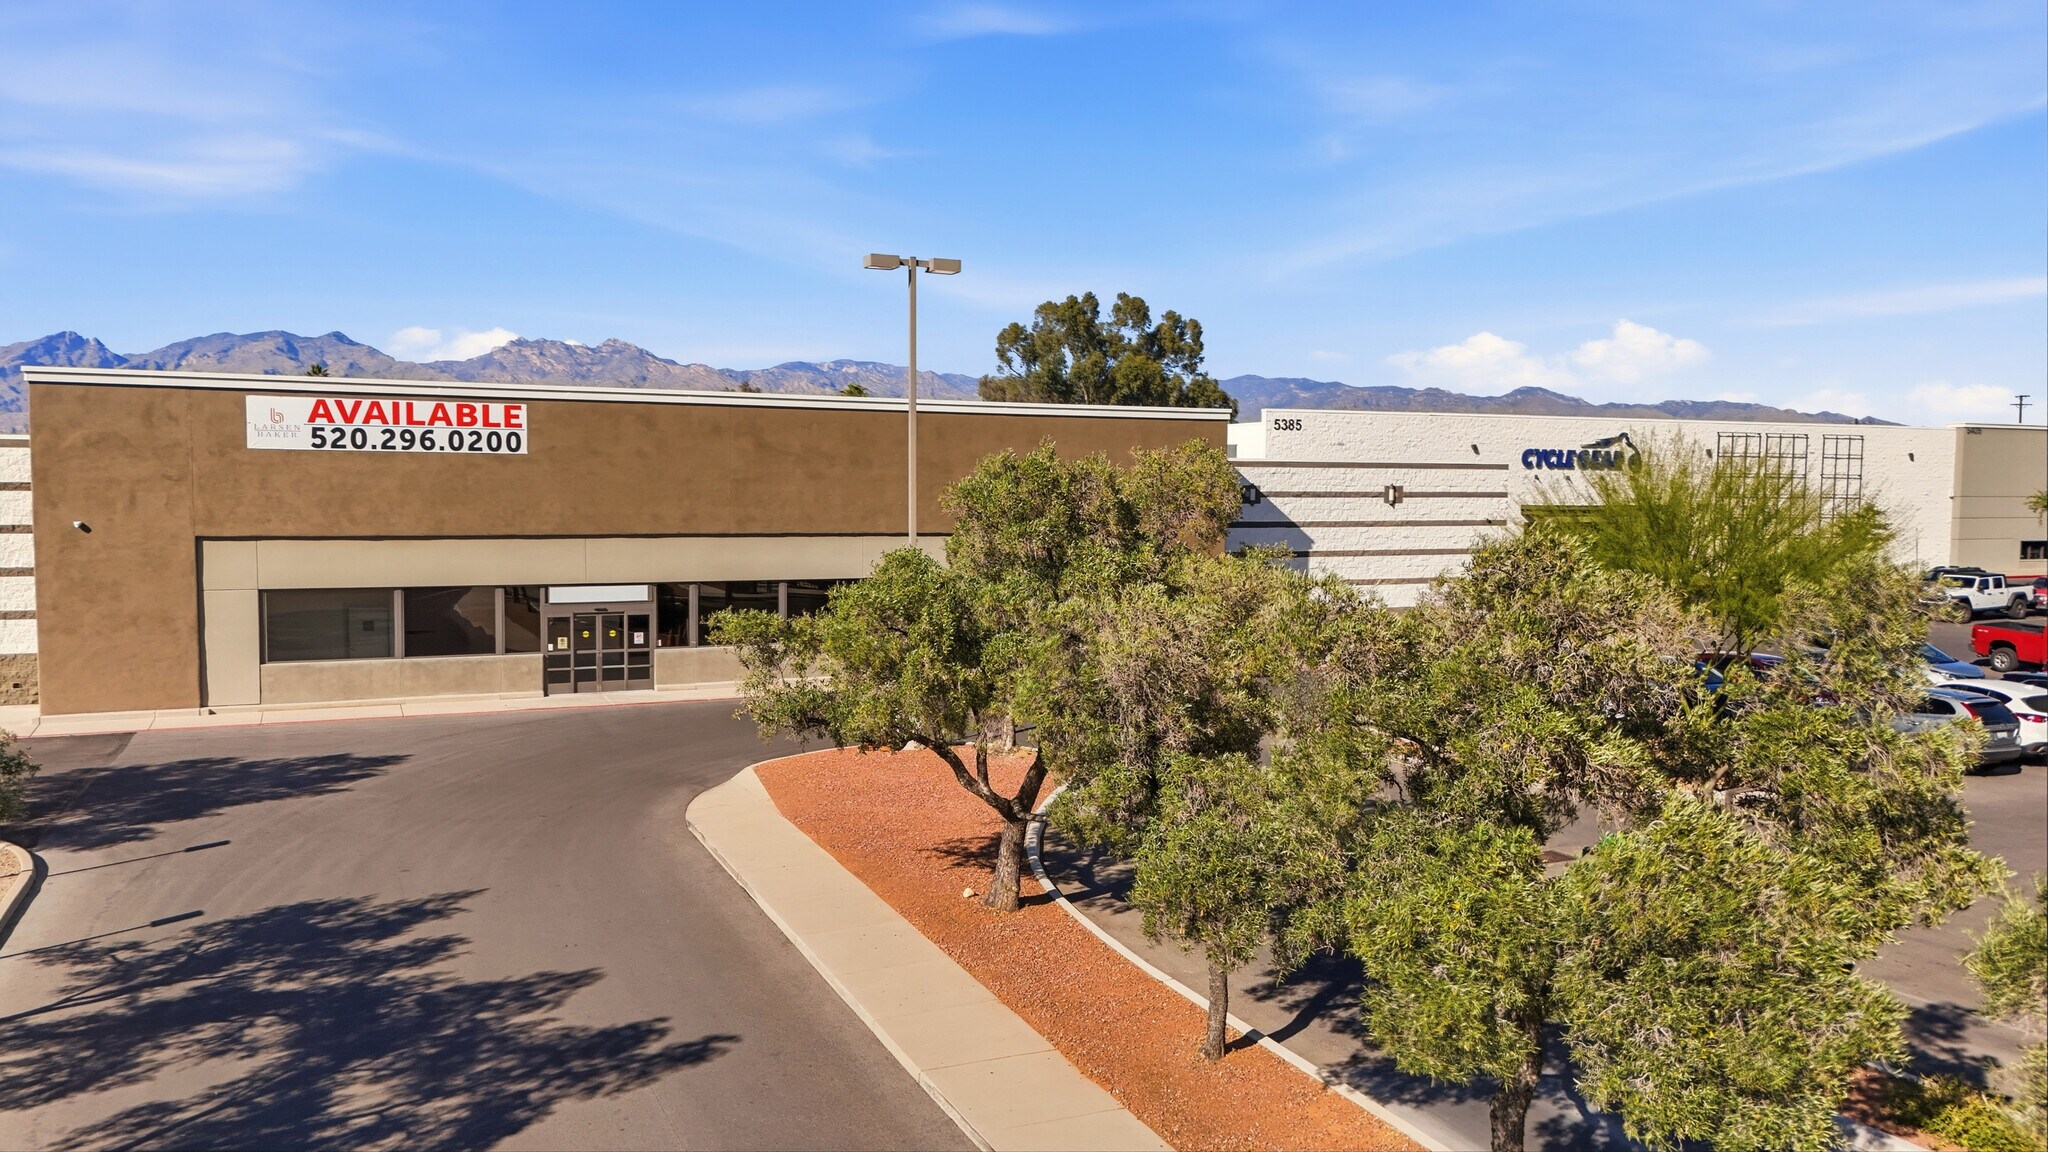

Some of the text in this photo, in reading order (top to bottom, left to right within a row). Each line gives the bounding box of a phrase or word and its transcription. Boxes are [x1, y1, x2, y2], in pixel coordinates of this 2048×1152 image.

[307, 399, 523, 428] AVAILABLE
[254, 423, 301, 431] LARSEN
[1274, 419, 1302, 431] 5385
[310, 427, 522, 452] 520.296.0200
